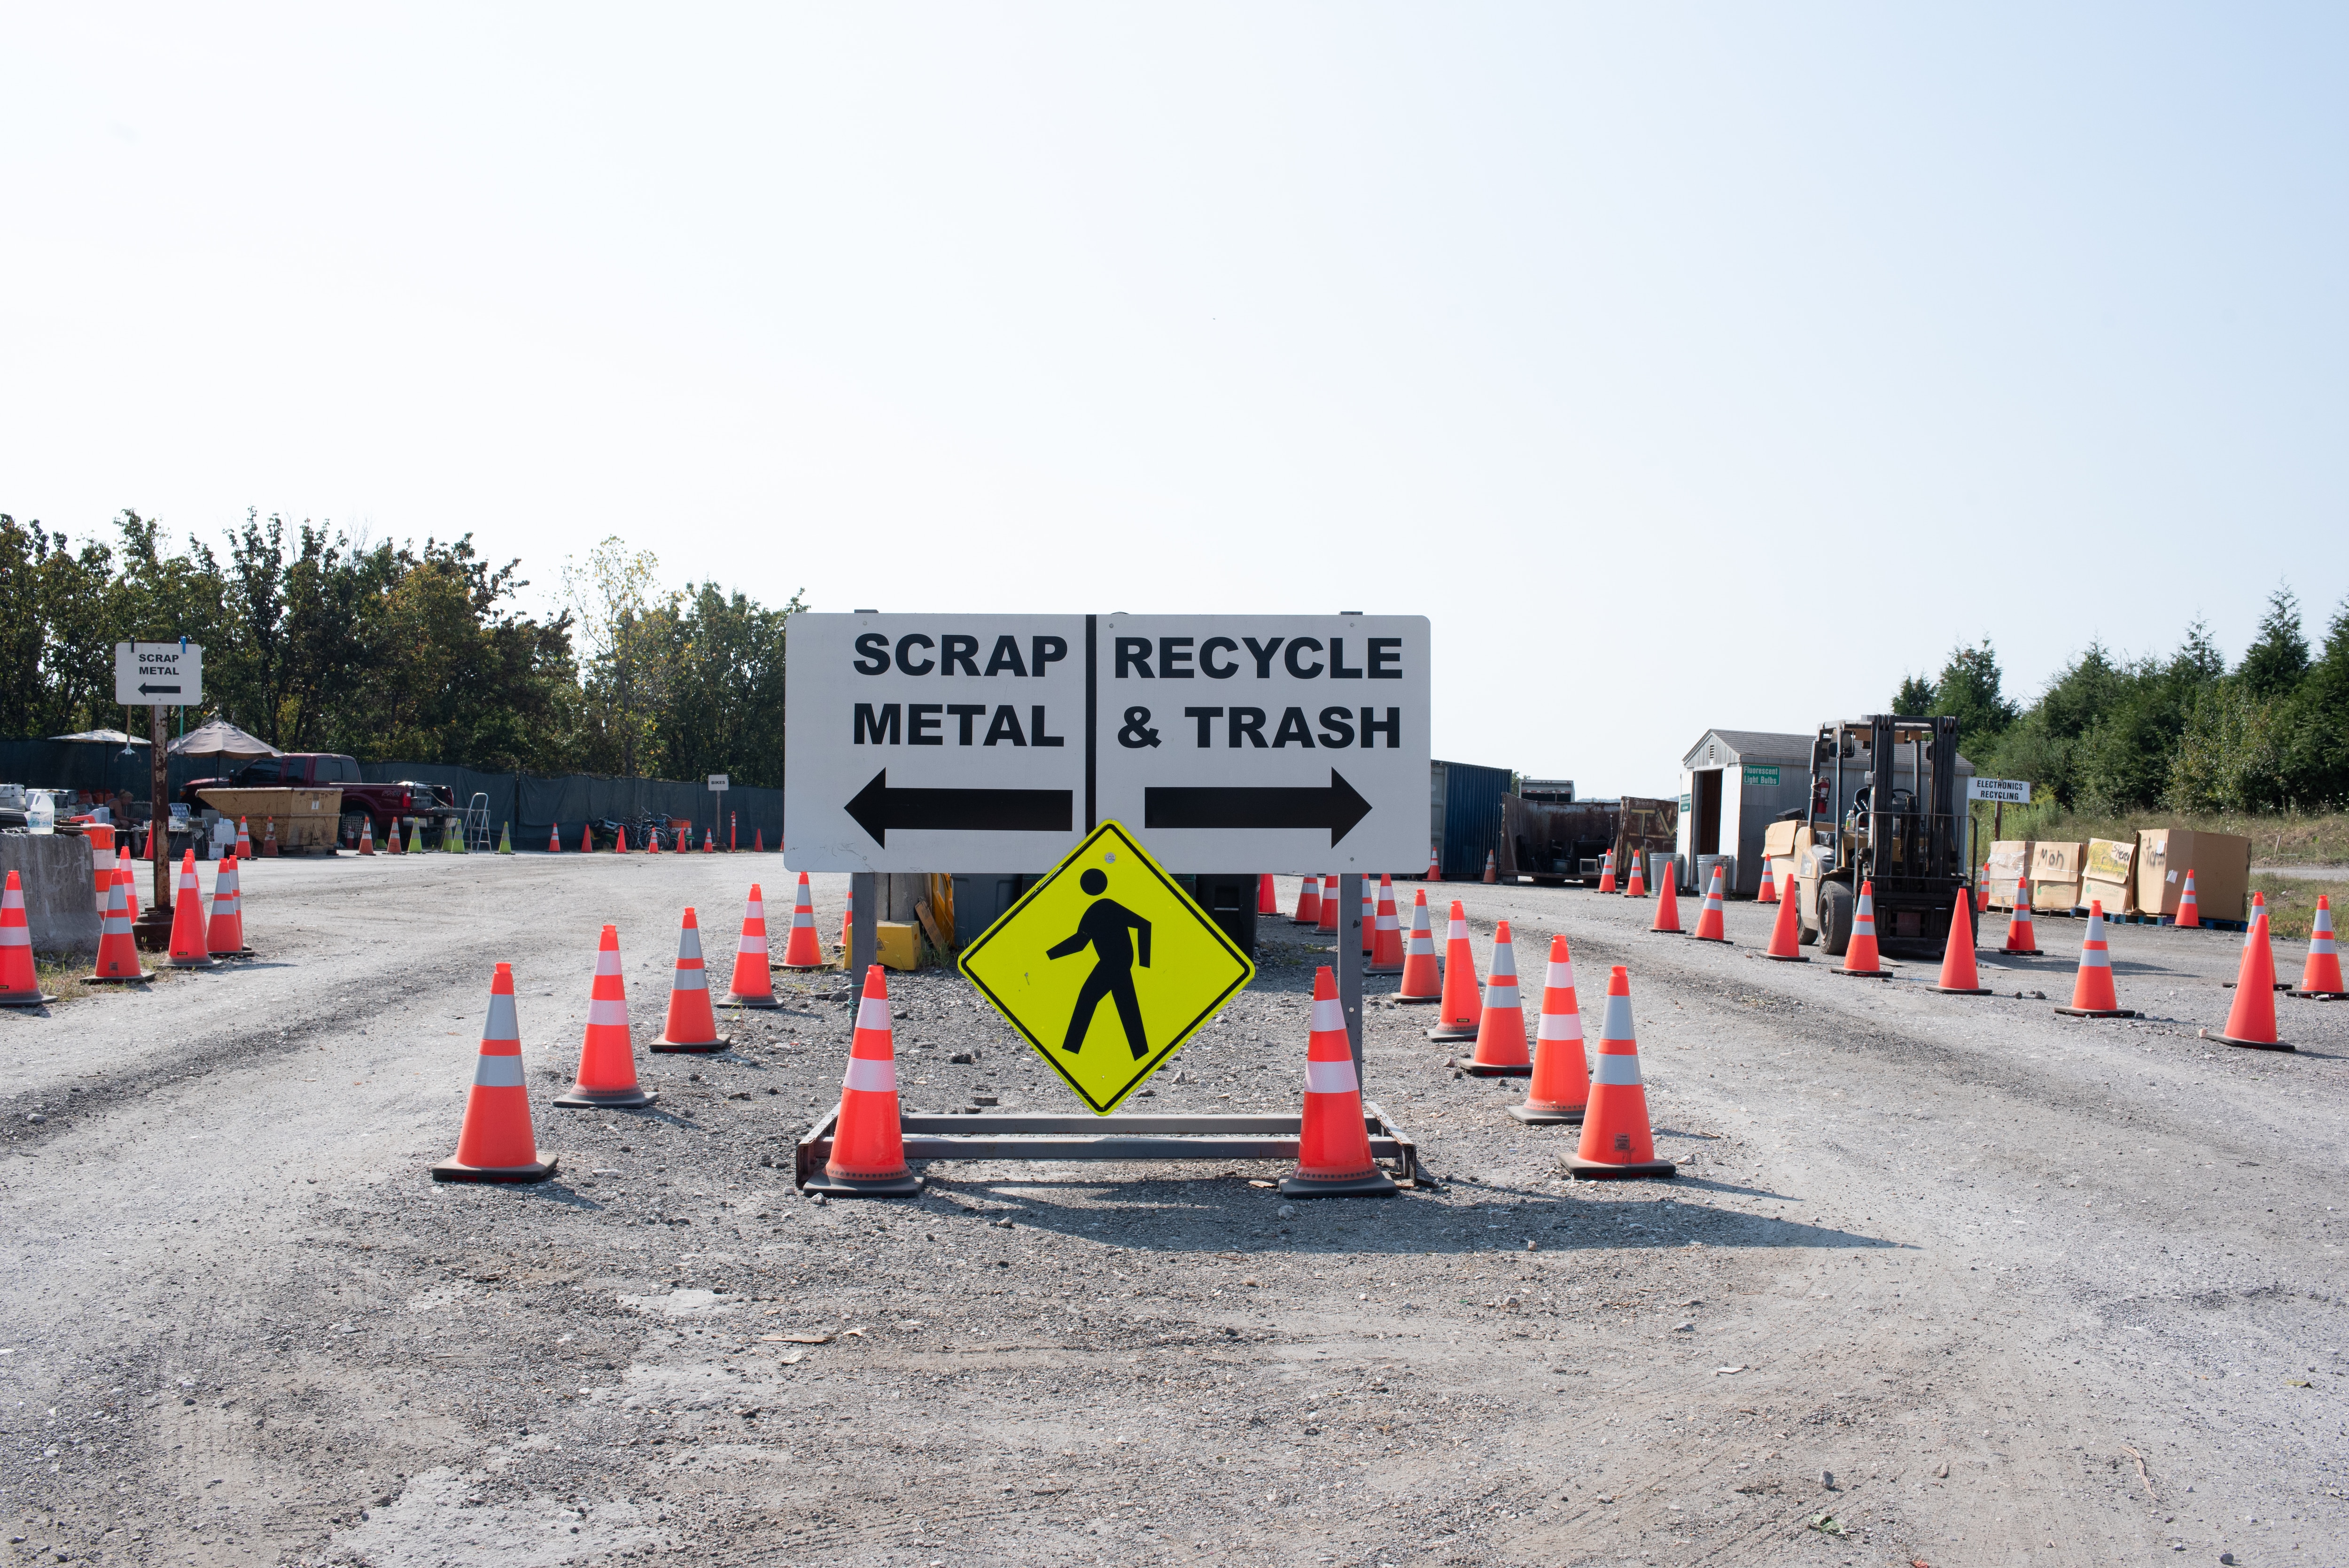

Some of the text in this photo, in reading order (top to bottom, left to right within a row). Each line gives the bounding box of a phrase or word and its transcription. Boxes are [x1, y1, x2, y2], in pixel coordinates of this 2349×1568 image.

[139, 654, 179, 663] SCRAP
[854, 633, 1067, 677] SCRAP
[1116, 637, 1402, 679] RECYCLE
[139, 667, 179, 675] METAL
[854, 703, 1064, 747] METAL
[1118, 706, 1400, 749] & TRASH
[1743, 766, 1778, 775] Fluorescent
[1744, 776, 1777, 784] Light Bulbs
[1976, 780, 2023, 791] ELECTRONICS
[1980, 791, 2019, 800] RECYCLING
